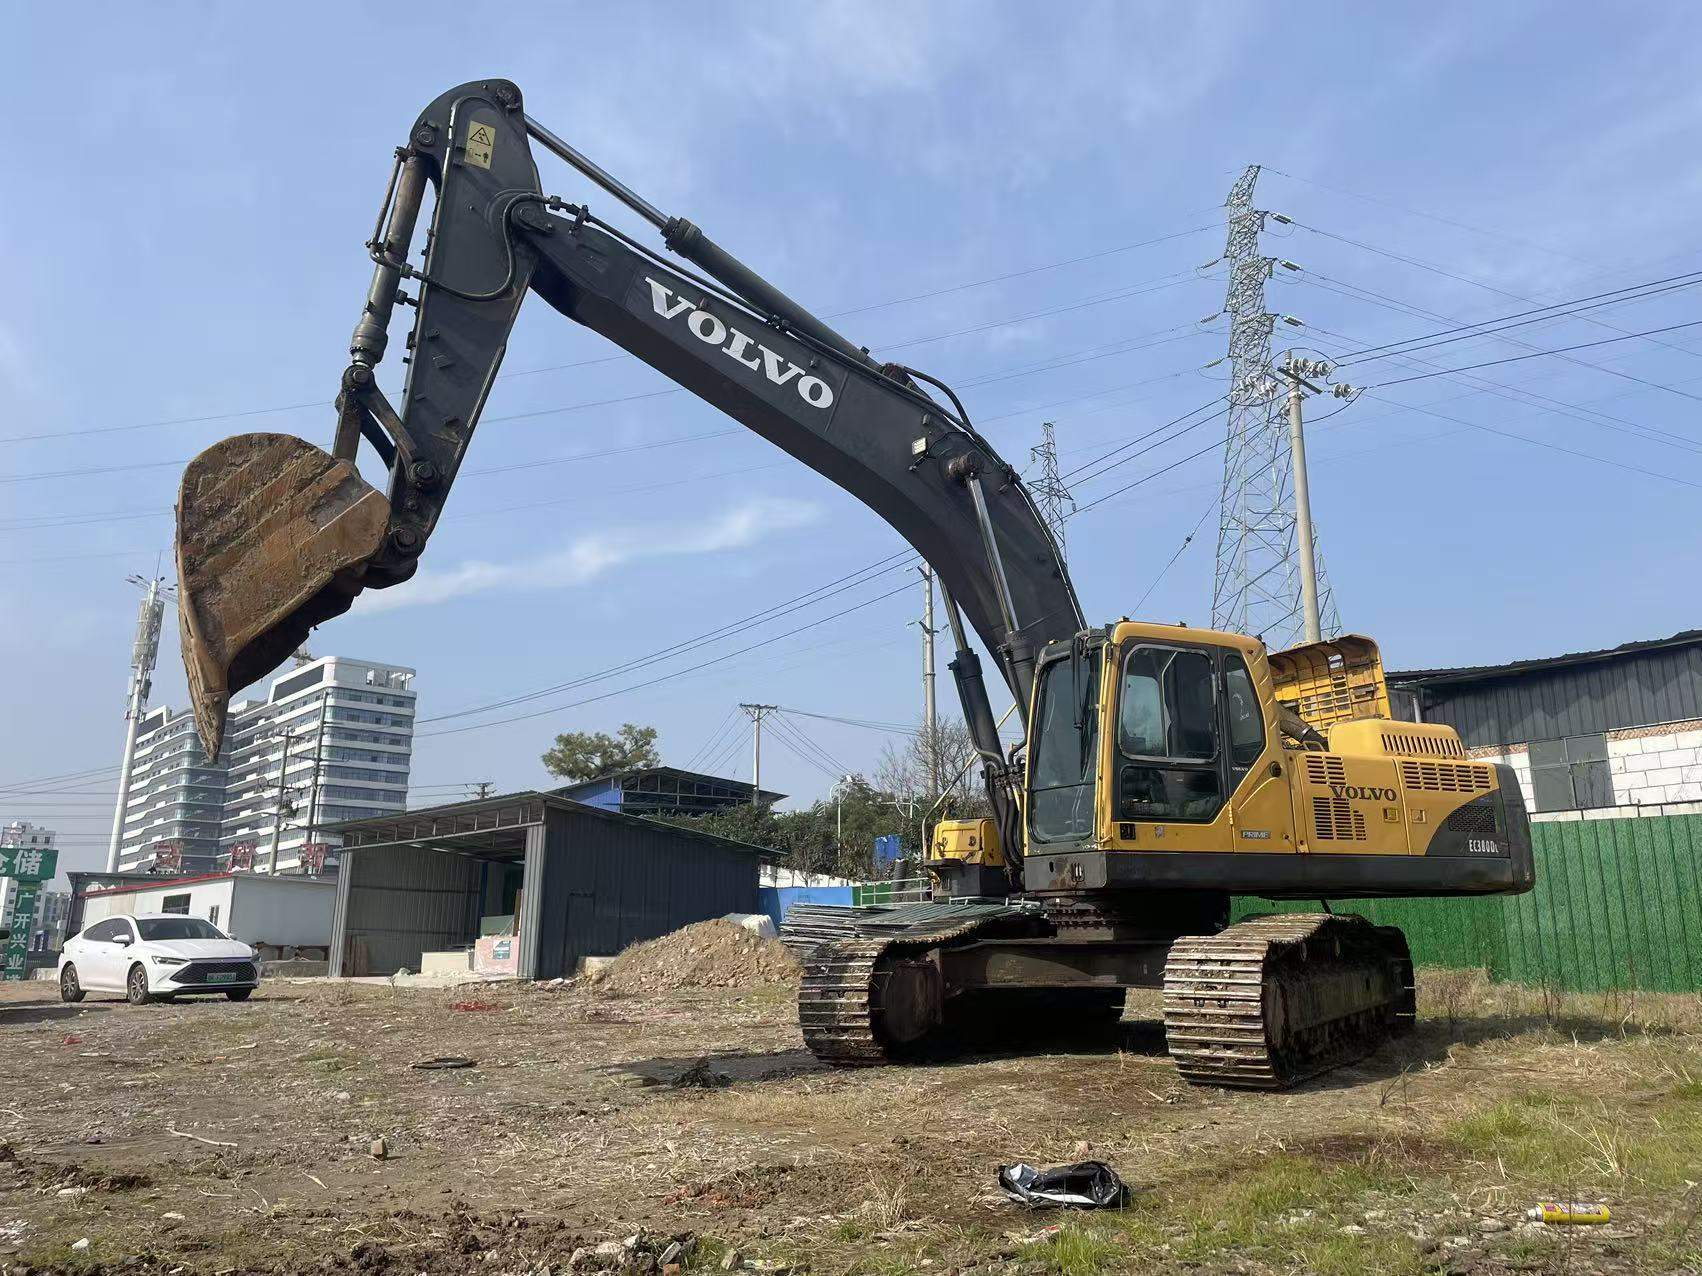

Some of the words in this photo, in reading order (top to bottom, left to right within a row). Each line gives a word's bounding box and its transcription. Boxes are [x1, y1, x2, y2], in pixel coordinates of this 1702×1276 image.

[644, 276, 834, 409] VOLVO
[1328, 784, 1397, 801] VOLVO
[1242, 831, 1270, 839] PRIME
